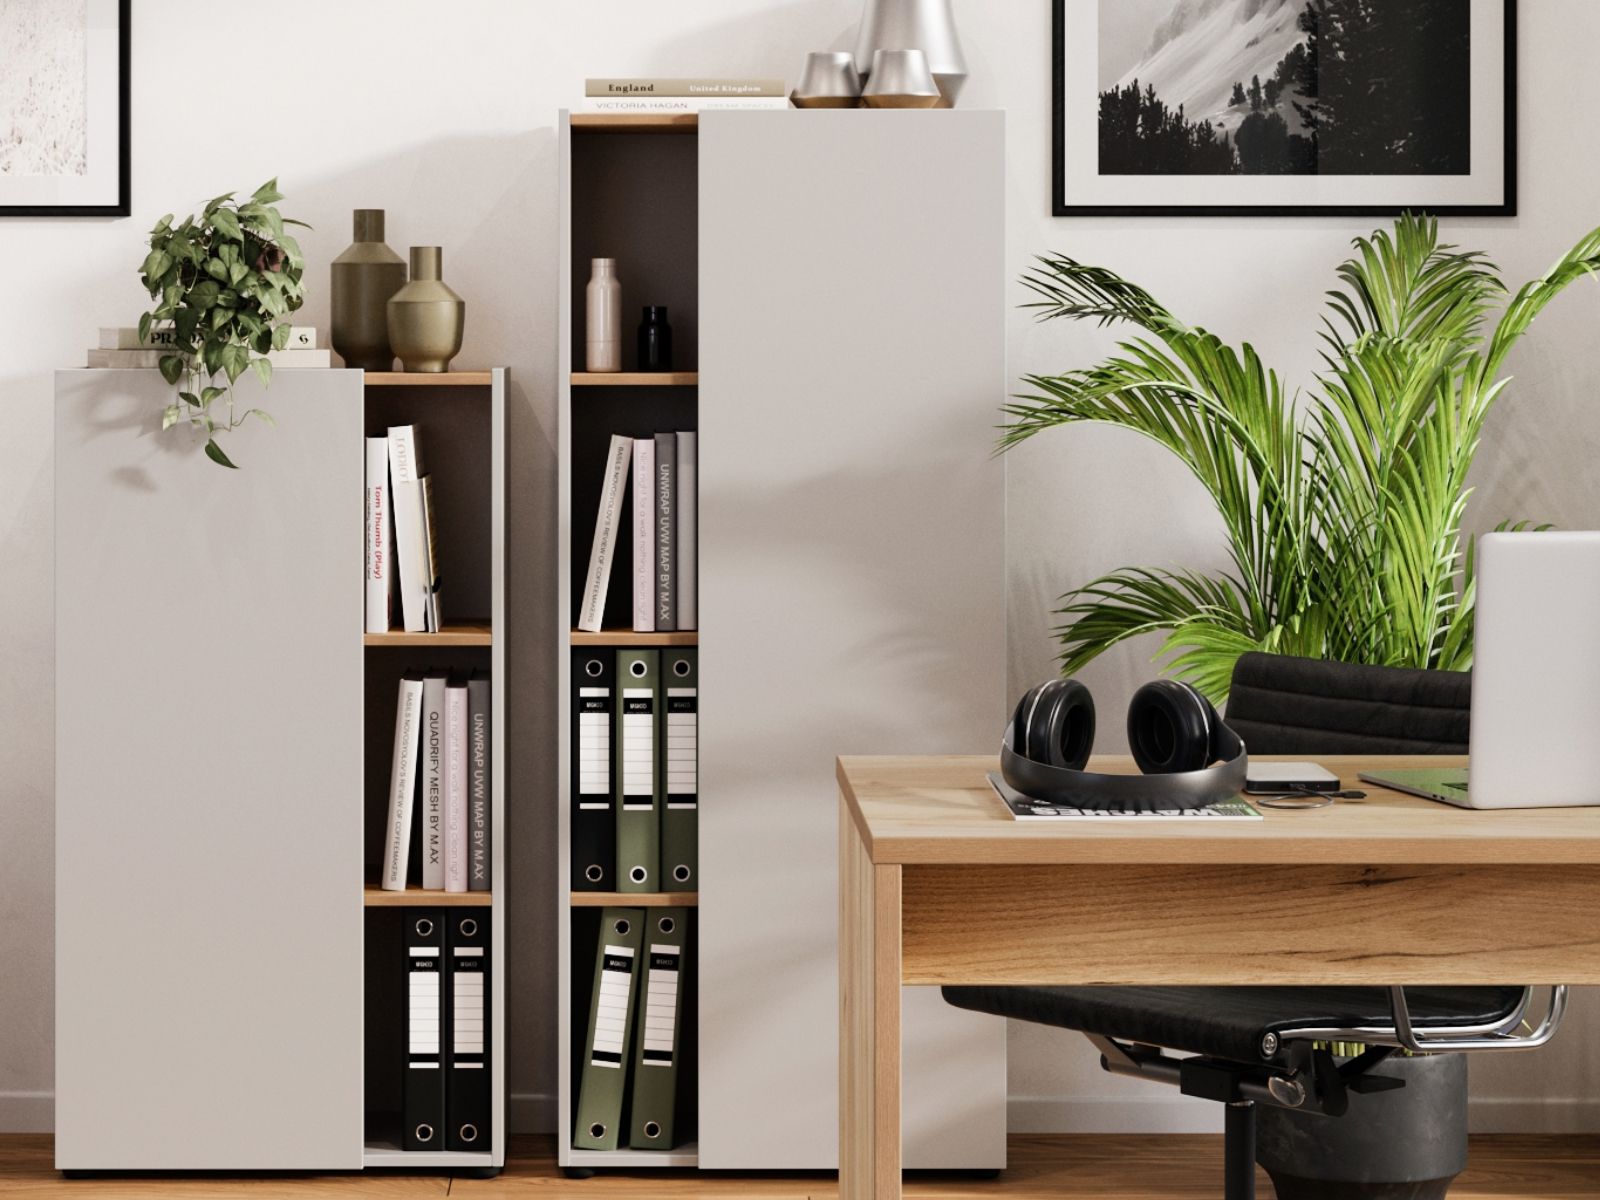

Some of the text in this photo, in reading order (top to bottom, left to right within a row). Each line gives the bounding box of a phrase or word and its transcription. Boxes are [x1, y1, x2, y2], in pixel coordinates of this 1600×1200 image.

[608, 84, 654, 93] England
[689, 84, 761, 93] United Kingdom
[660, 464, 670, 514] UNWRAP
[373, 486, 382, 580] Tom Thumb (Play)
[600, 527, 610, 554] REVIEW
[660, 517, 670, 544] UVW
[598, 556, 605, 565] OF
[660, 547, 670, 571] MAP
[587, 566, 603, 623] COFFEEMAKERS
[660, 574, 670, 589] BY
[429, 711, 439, 774] QUADRIFY
[474, 713, 484, 767] UNWRAP
[398, 779, 407, 808] REVIEW
[429, 777, 439, 812] MESH
[474, 770, 484, 798] UVW
[396, 809, 403, 820] OF
[429, 815, 439, 831] BY
[474, 801, 484, 827] MAP
[390, 821, 403, 882] COFFEEMAKERS
[474, 830, 484, 846] BY
